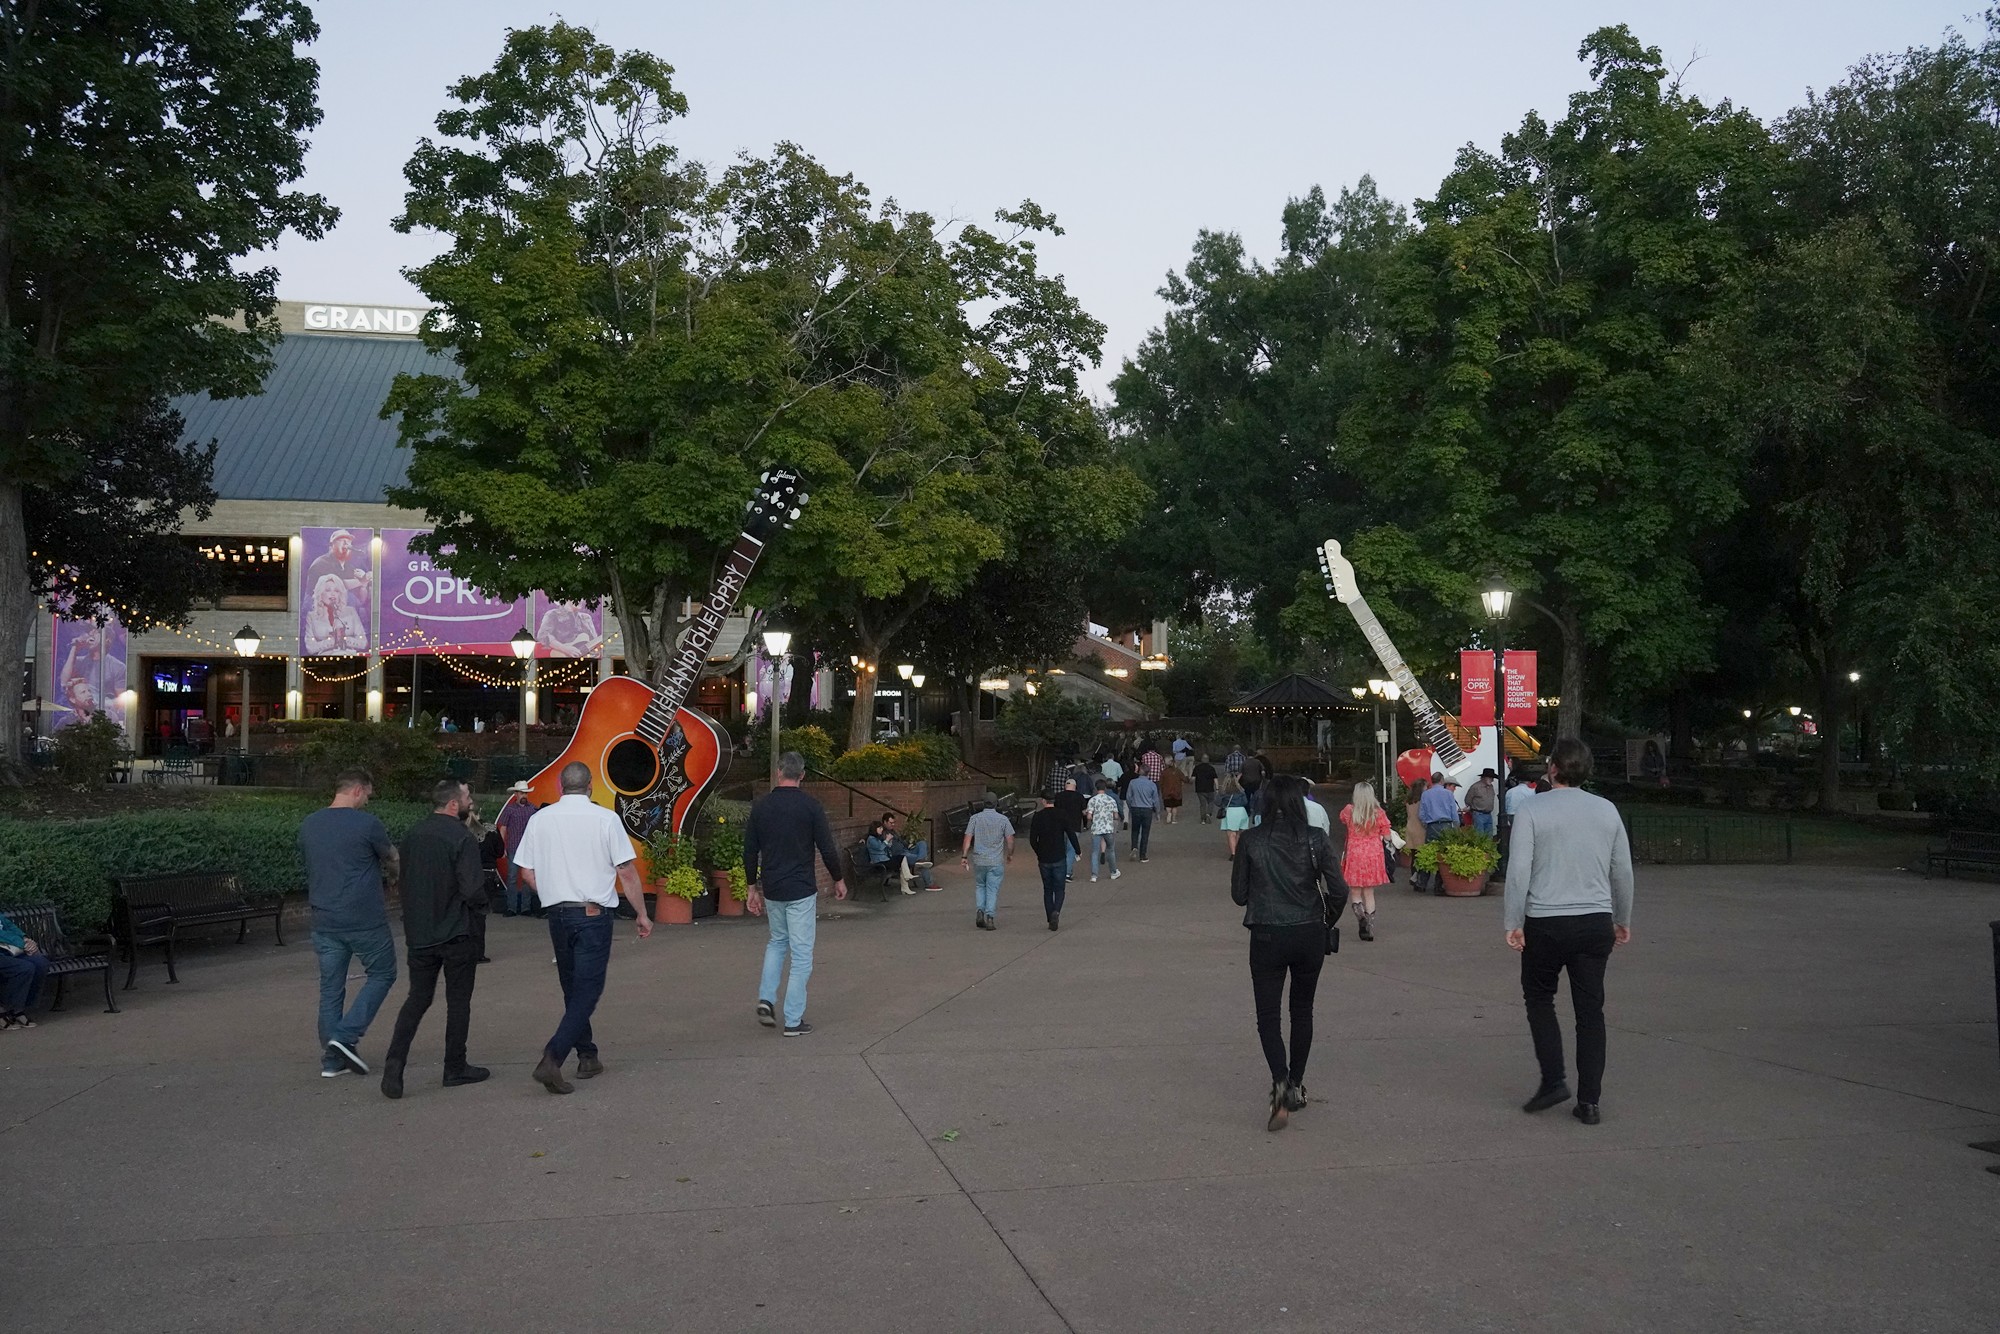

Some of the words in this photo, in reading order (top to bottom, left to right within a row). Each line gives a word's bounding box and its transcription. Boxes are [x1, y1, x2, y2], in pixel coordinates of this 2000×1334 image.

[305, 305, 418, 332] GRAND
[659, 649, 698, 712] GRAND
[692, 612, 718, 648] OLE
[711, 563, 740, 611] OPRY
[1368, 624, 1400, 668] GRAND
[1467, 681, 1489, 690] OPRY
